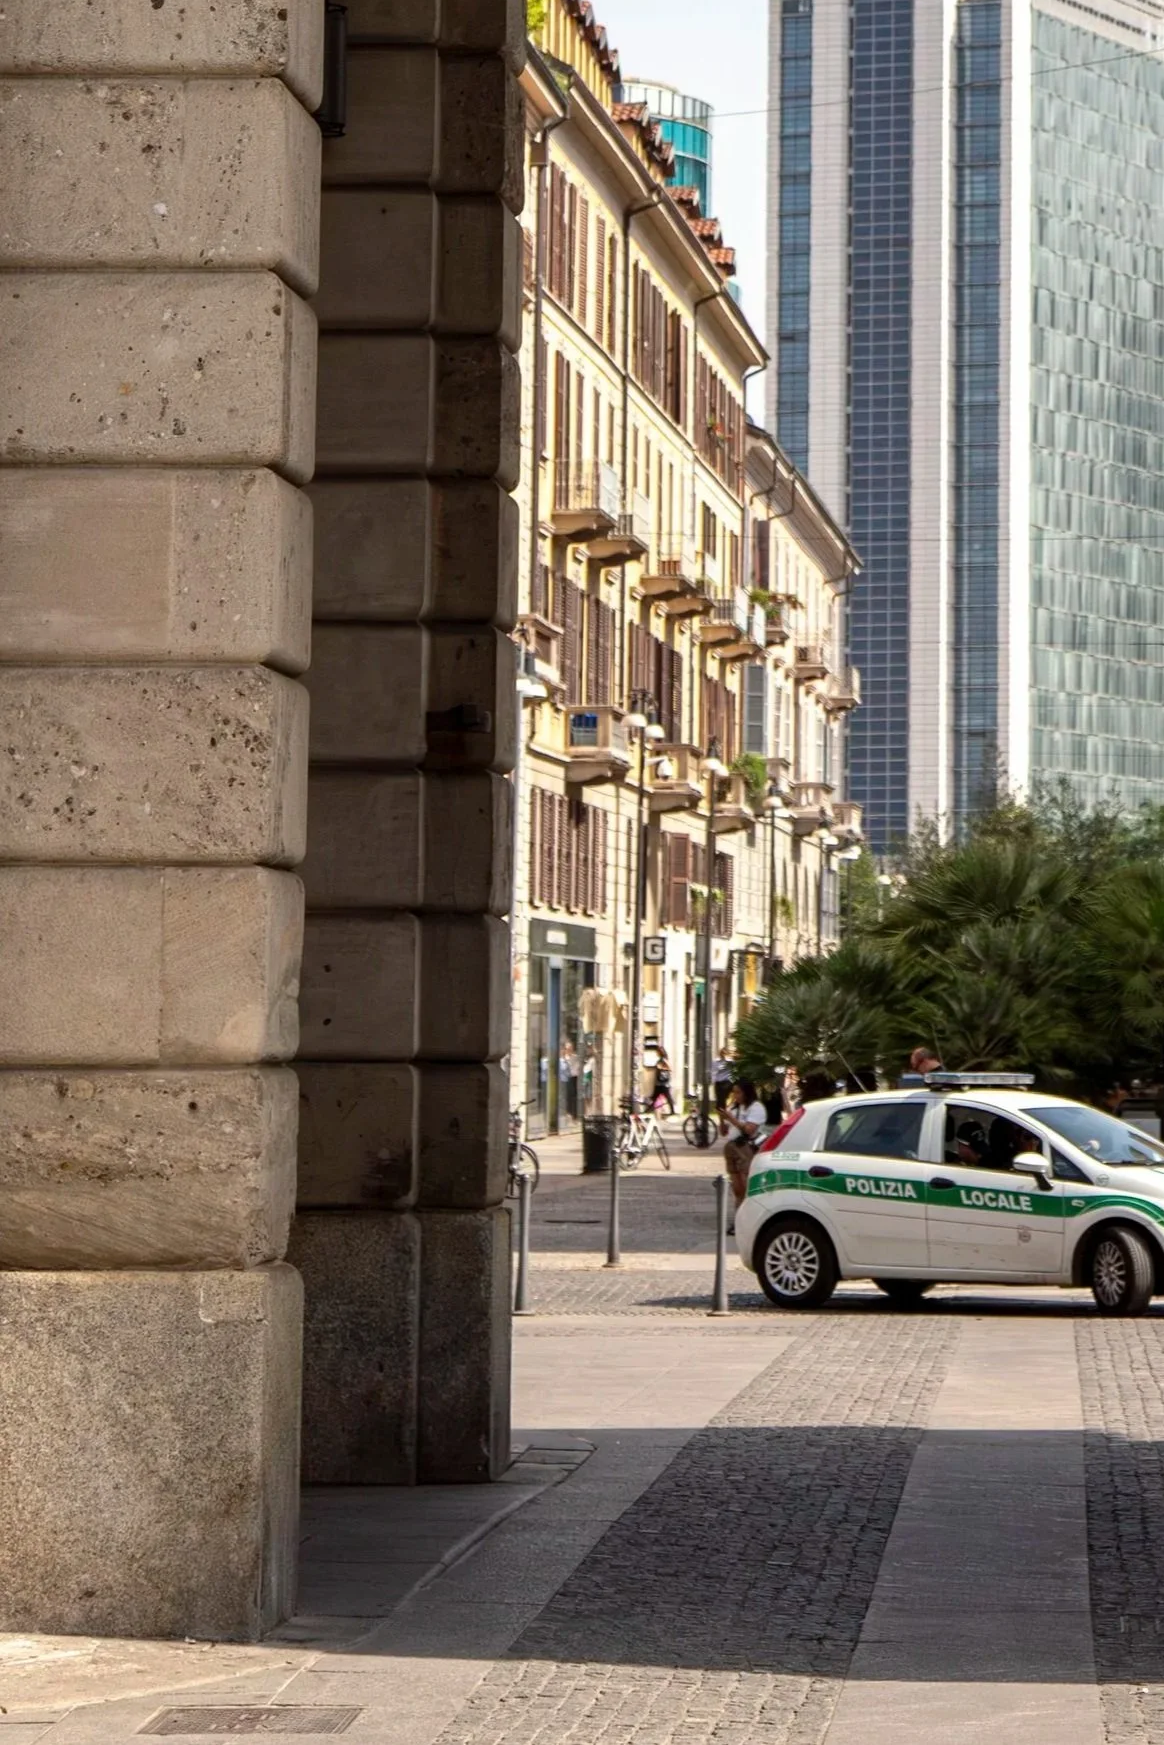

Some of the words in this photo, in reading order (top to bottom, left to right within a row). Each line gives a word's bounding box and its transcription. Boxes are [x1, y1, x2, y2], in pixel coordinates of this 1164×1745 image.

[645, 938, 664, 960] G
[845, 1177, 917, 1199] POLIZIA
[960, 1189, 1033, 1211] LOCALE
